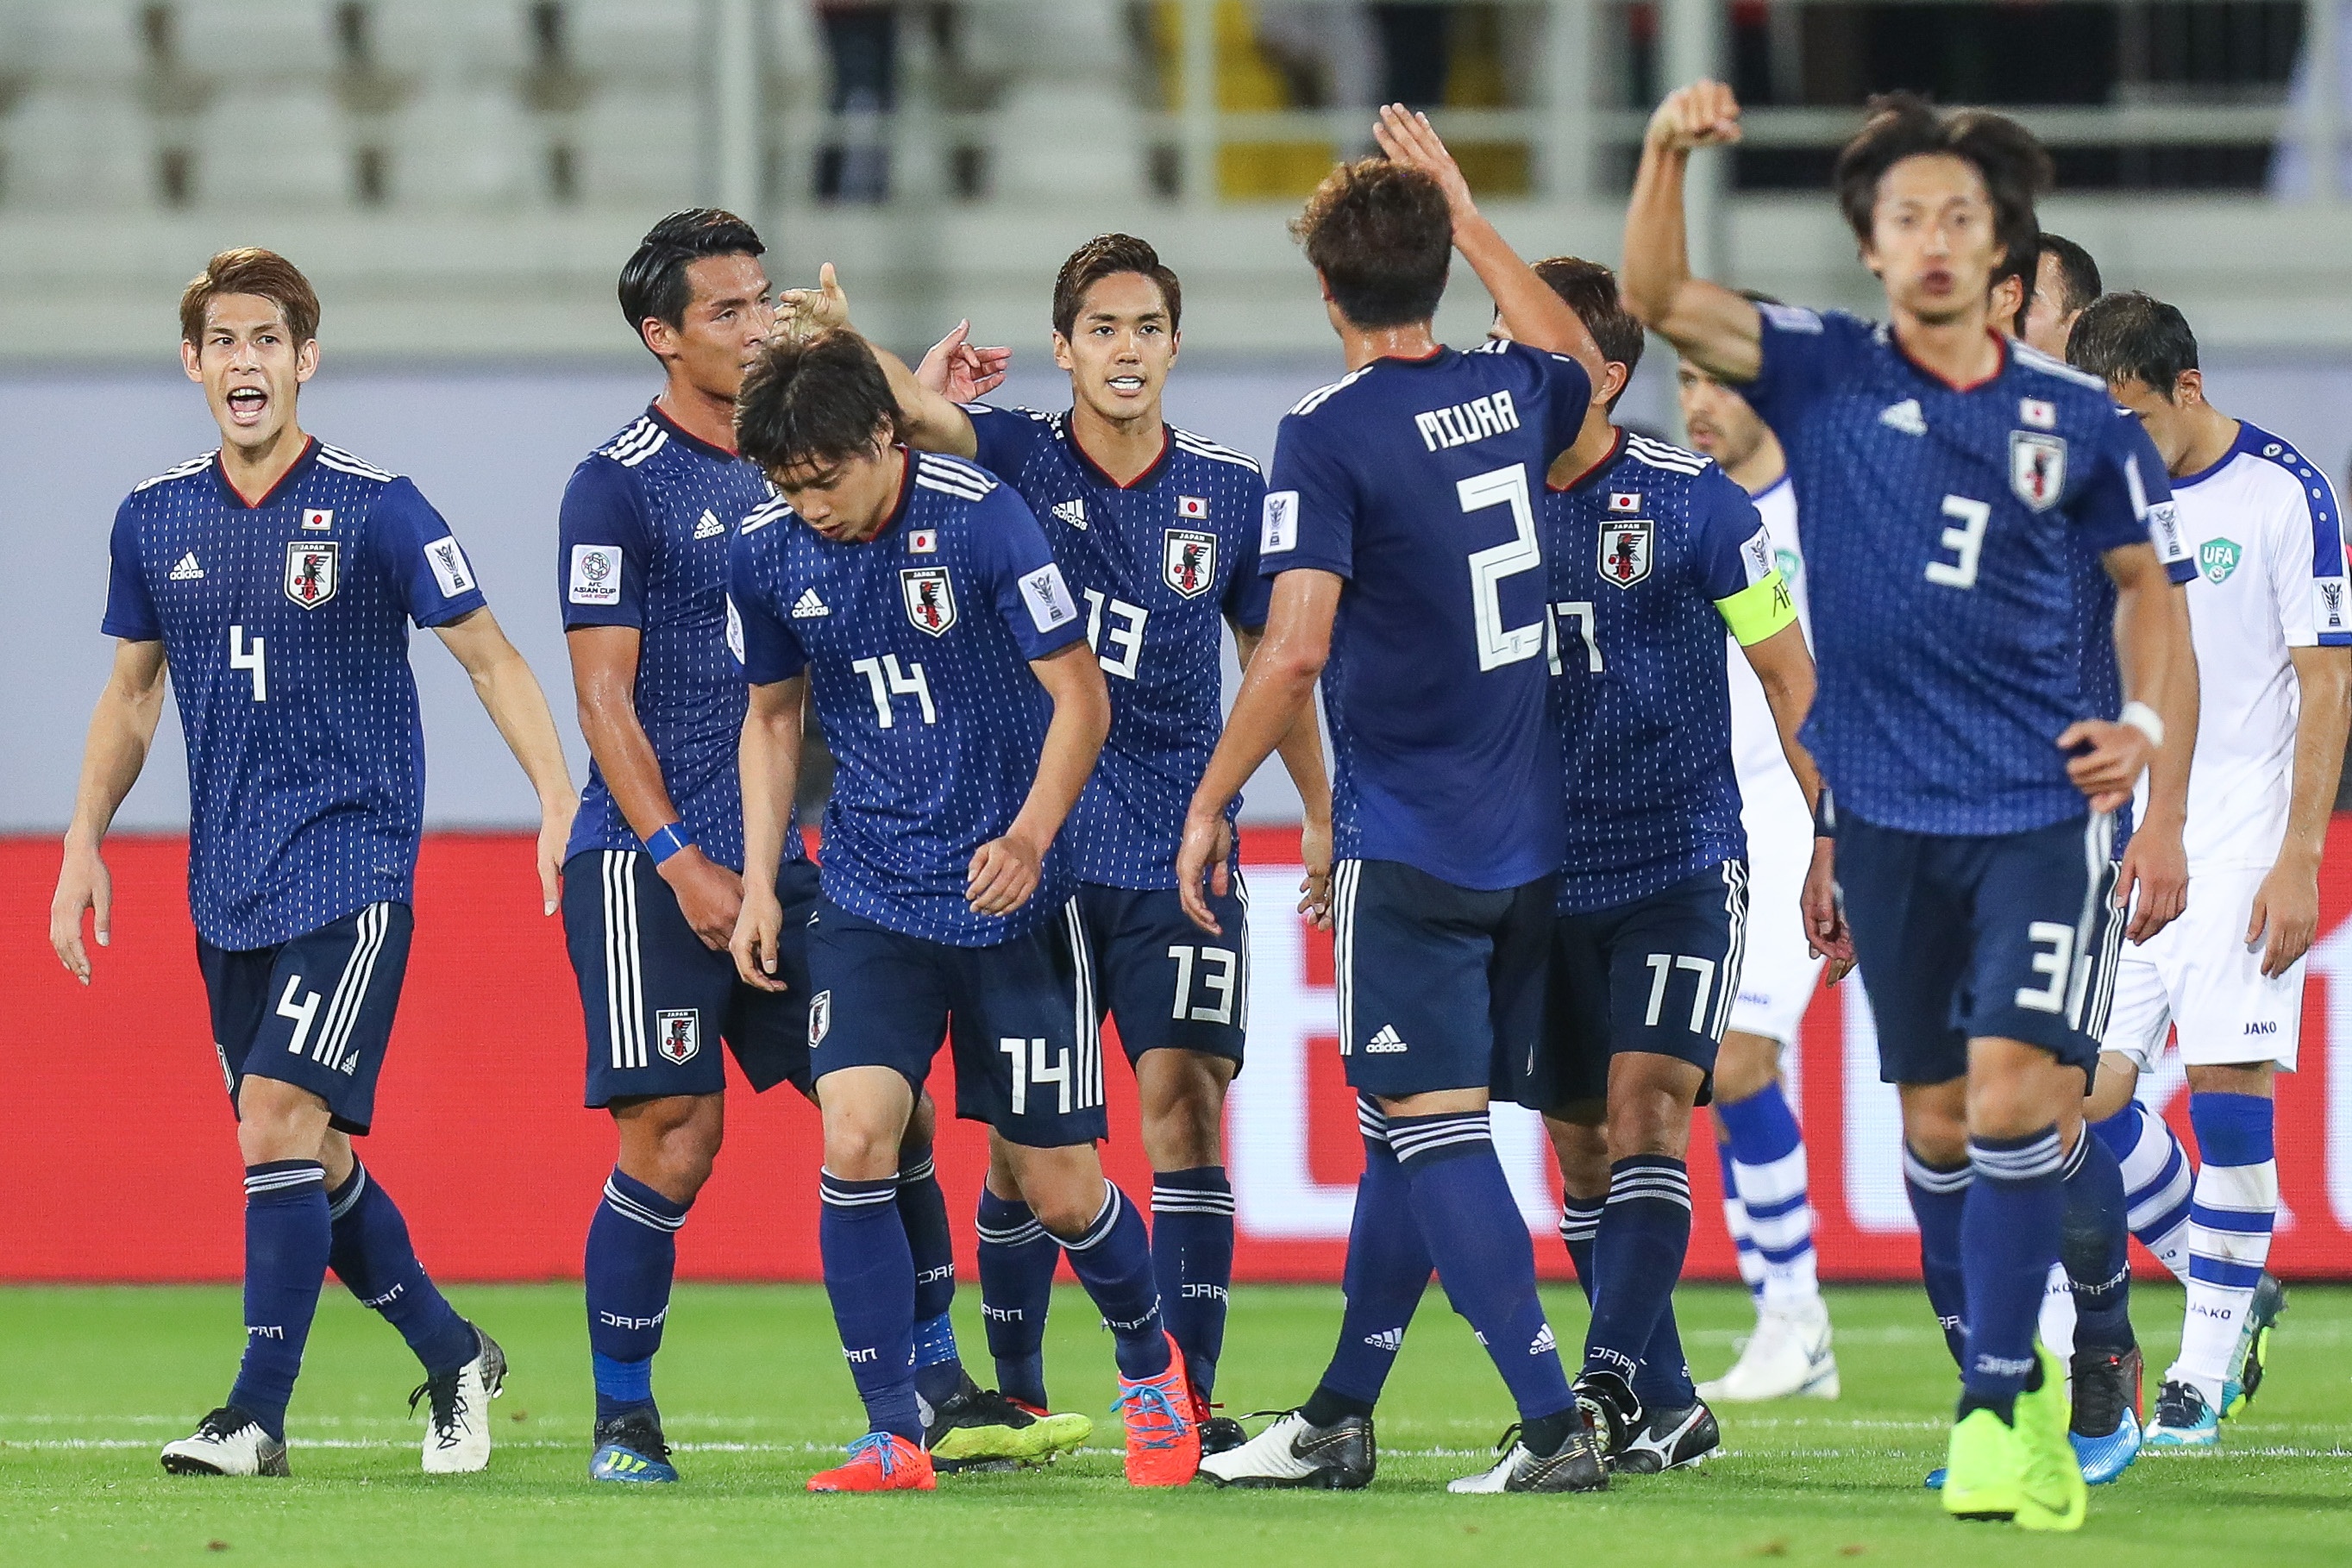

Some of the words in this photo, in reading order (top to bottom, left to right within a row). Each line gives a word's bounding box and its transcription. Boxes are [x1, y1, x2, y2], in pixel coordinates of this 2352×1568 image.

[1414, 389, 1521, 453] MIURA
[693, 523, 725, 540] adidas
[1051, 505, 1088, 531] adidas
[1179, 532, 1206, 543] JAPAN
[1924, 494, 1991, 589] 3
[2203, 546, 2235, 565] UFA
[169, 568, 204, 580] adidas
[1456, 462, 1544, 672] 2
[792, 604, 829, 619] adidas
[1083, 586, 1149, 681] 13
[1546, 600, 1603, 676] 17
[229, 625, 267, 701] 4
[852, 653, 937, 729] 14
[1168, 945, 1236, 1025] 13
[1645, 954, 1715, 1034] 17
[2013, 921, 2075, 1014] 3
[275, 974, 322, 1055] 4
[1365, 1041, 1408, 1054] adidas
[2243, 1021, 2277, 1035] JAKO
[1000, 1038, 1070, 1115] 14
[2190, 1301, 2232, 1320] JAKO
